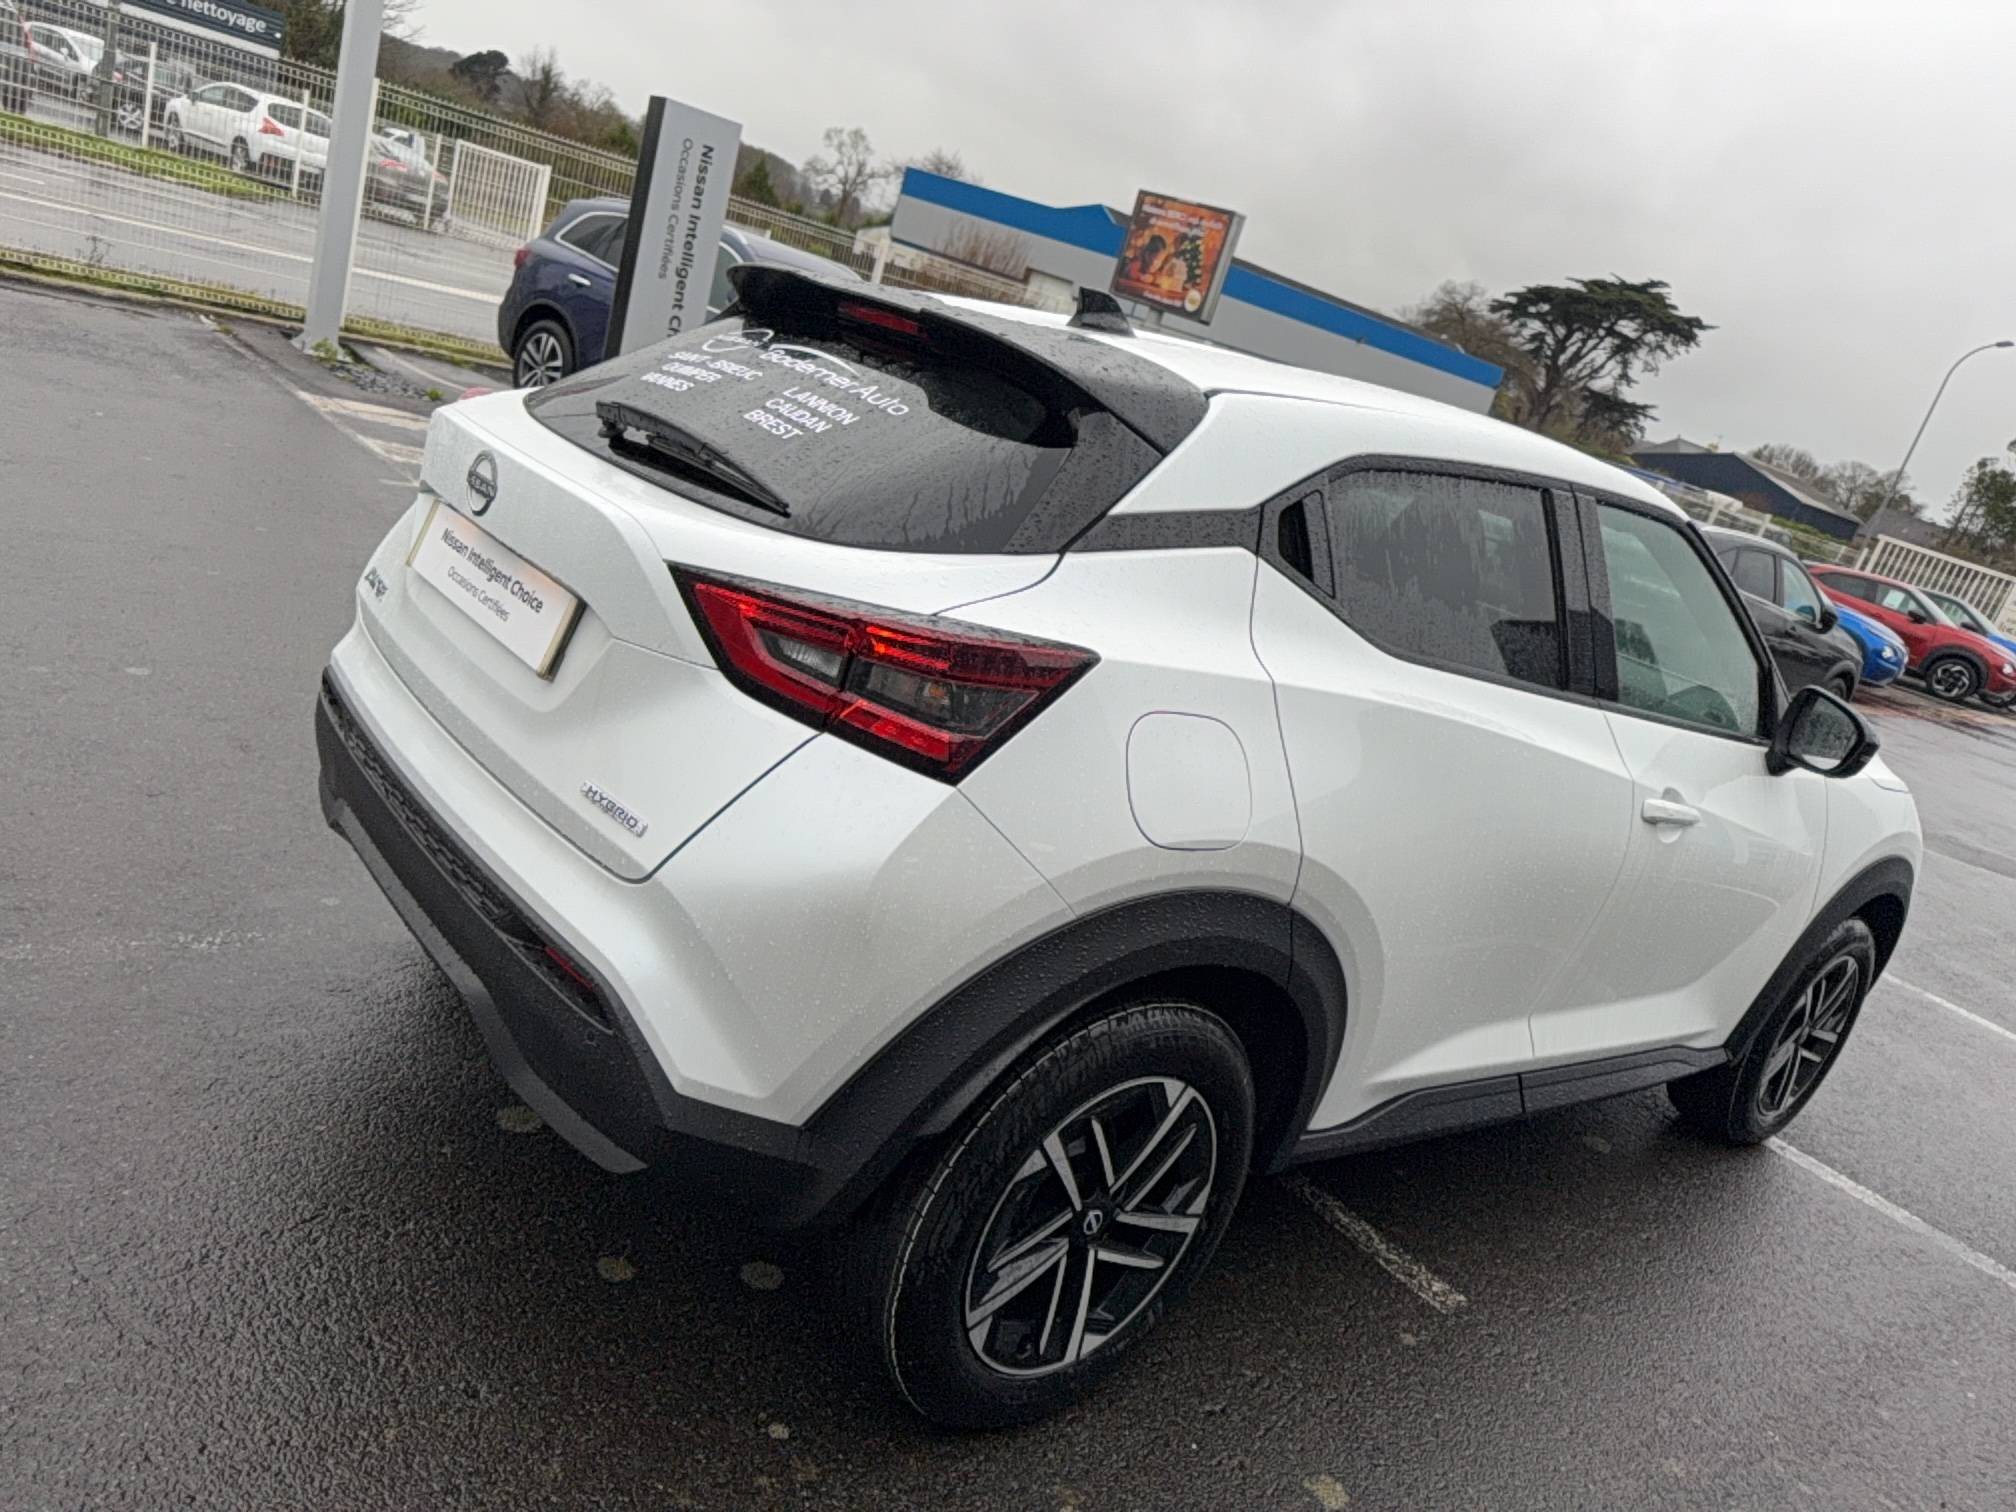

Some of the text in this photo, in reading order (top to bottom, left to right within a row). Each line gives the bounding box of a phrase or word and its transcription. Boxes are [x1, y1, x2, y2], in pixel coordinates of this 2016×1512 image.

[180, 0, 267, 33] nettoyage
[671, 138, 693, 211] Occasions
[691, 144, 715, 209] Nissan
[672, 213, 702, 311] Intelligent
[743, 409, 804, 439] BREST
[765, 398, 833, 434] CAUDAN
[783, 386, 860, 426] LANNION
[440, 527, 544, 614] Nissan Intelligent Choice
[447, 566, 478, 597] Occasions
[584, 785, 639, 831] HYBRID
